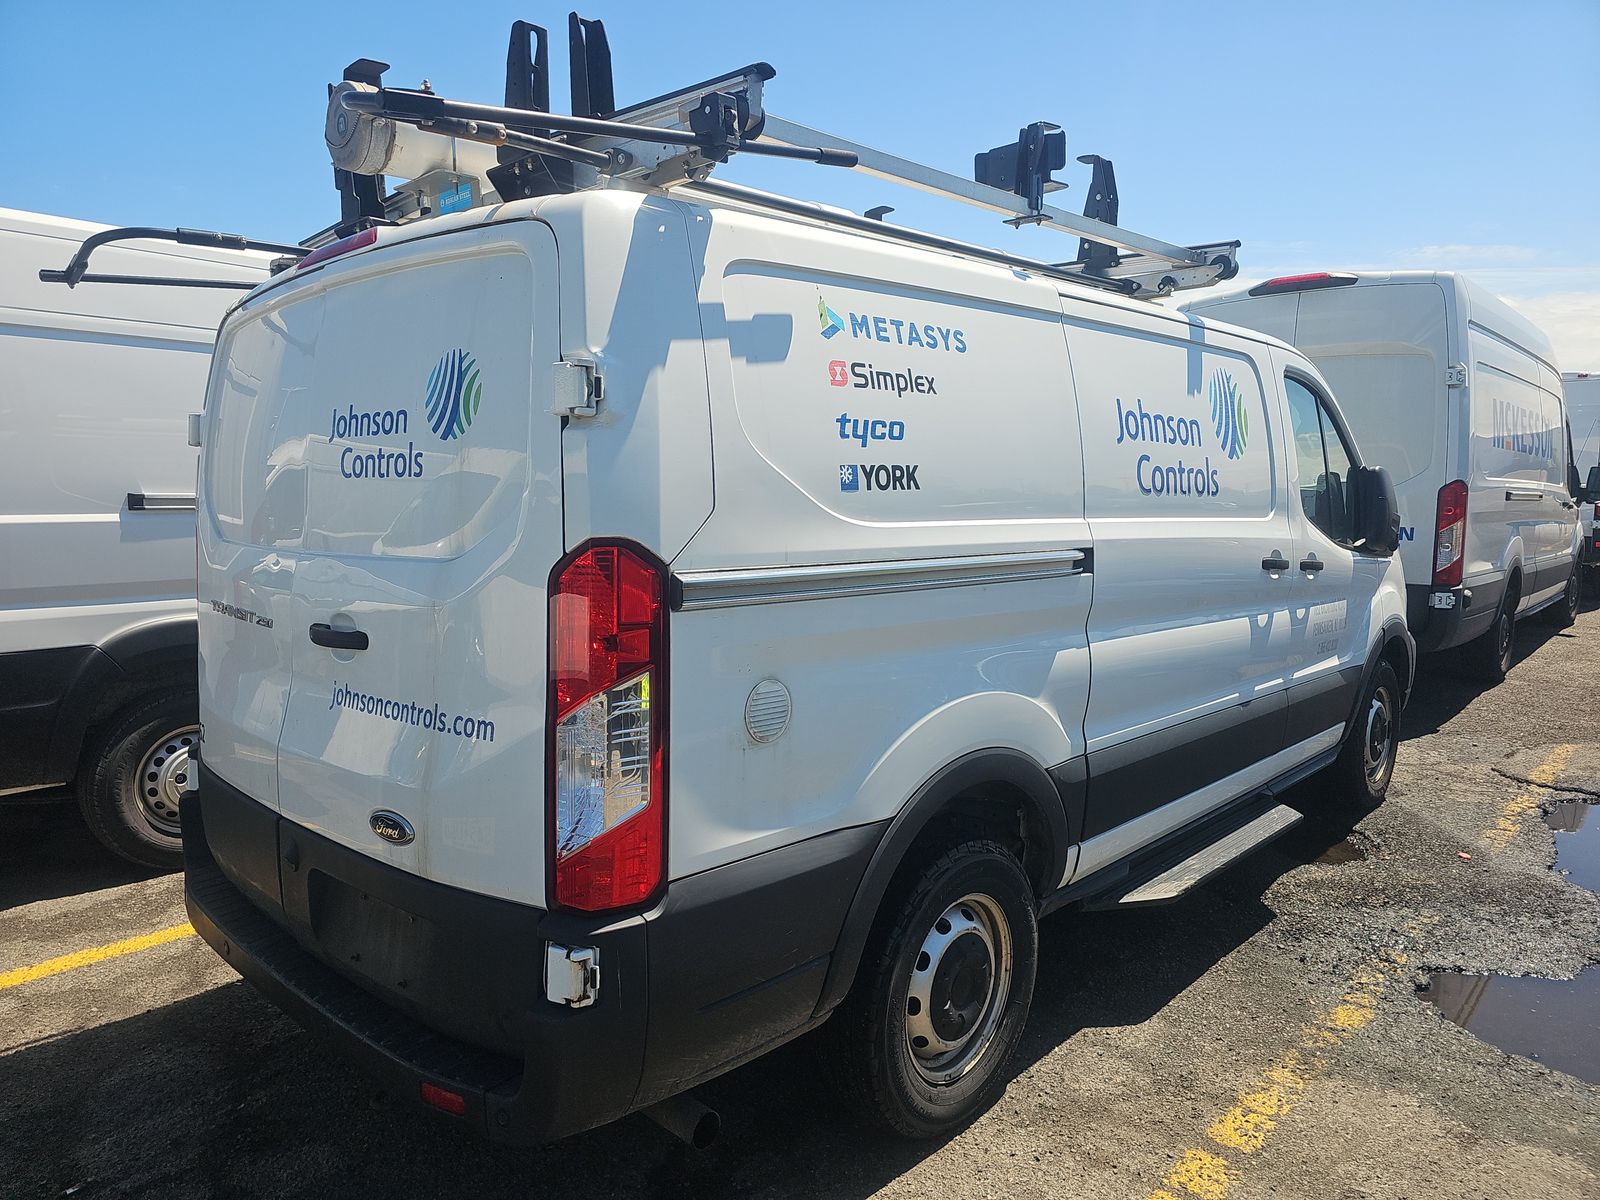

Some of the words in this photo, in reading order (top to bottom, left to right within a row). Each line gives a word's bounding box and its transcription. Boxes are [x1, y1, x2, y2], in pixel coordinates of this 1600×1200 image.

[848, 312, 967, 354] METASYS
[850, 362, 937, 398] Simplex
[328, 404, 408, 443] Johnson
[835, 412, 905, 448] tyco
[1116, 399, 1201, 447] Johnson
[340, 441, 424, 479] Controls
[859, 464, 921, 491] YORK
[1136, 454, 1219, 497] Controls
[211, 599, 256, 624] TRANSIT
[328, 680, 495, 742] johnsoncontrols.com
[375, 817, 400, 839] Ford
